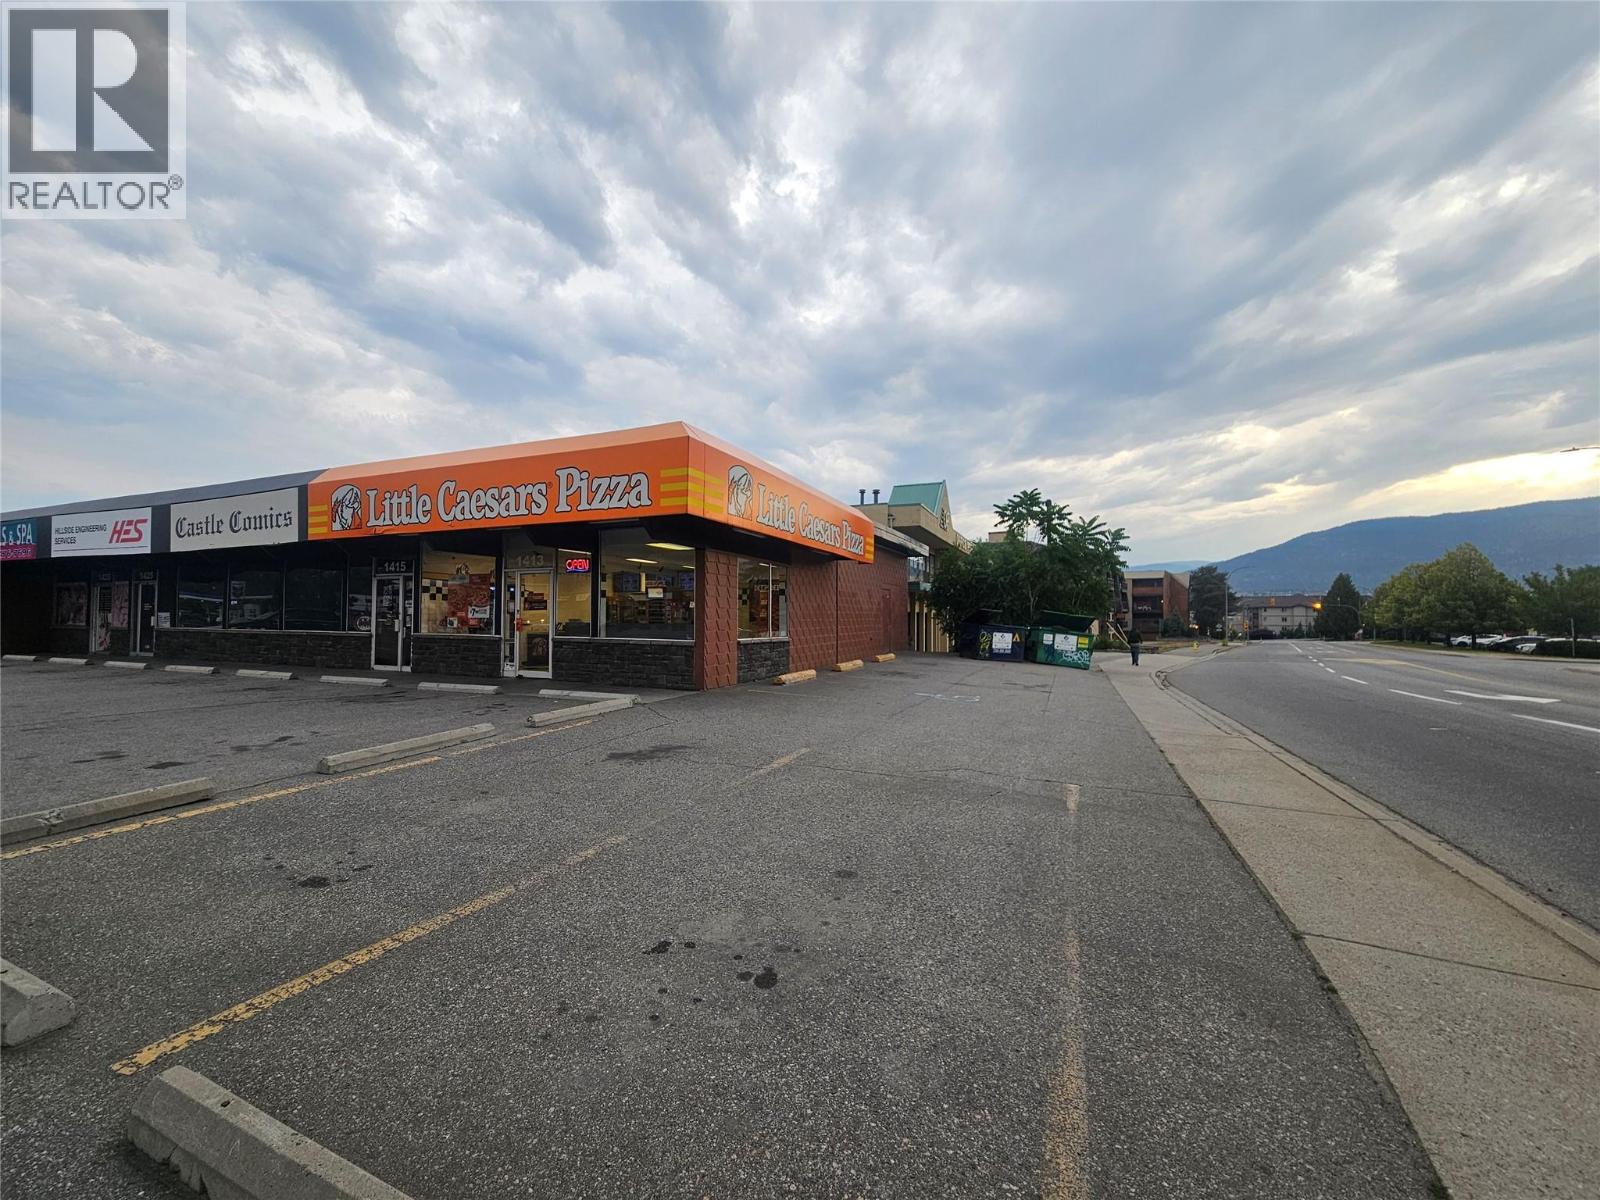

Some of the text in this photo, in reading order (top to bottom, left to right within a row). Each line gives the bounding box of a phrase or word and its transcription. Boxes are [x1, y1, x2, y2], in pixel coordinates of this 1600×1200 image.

[366, 484, 432, 528] Little
[554, 466, 652, 514] Pizza
[175, 506, 293, 539] Castle Comics
[756, 482, 865, 556] Little Caesars Pizza
[16, 523, 33, 545] SPA
[54, 523, 107, 535] HILLSIDE ENGINEERING
[109, 519, 149, 545] HES
[54, 536, 77, 545] SERVICES
[383, 560, 407, 573] 1415
[516, 554, 544, 568] 1413
[565, 557, 590, 571] OPEN
